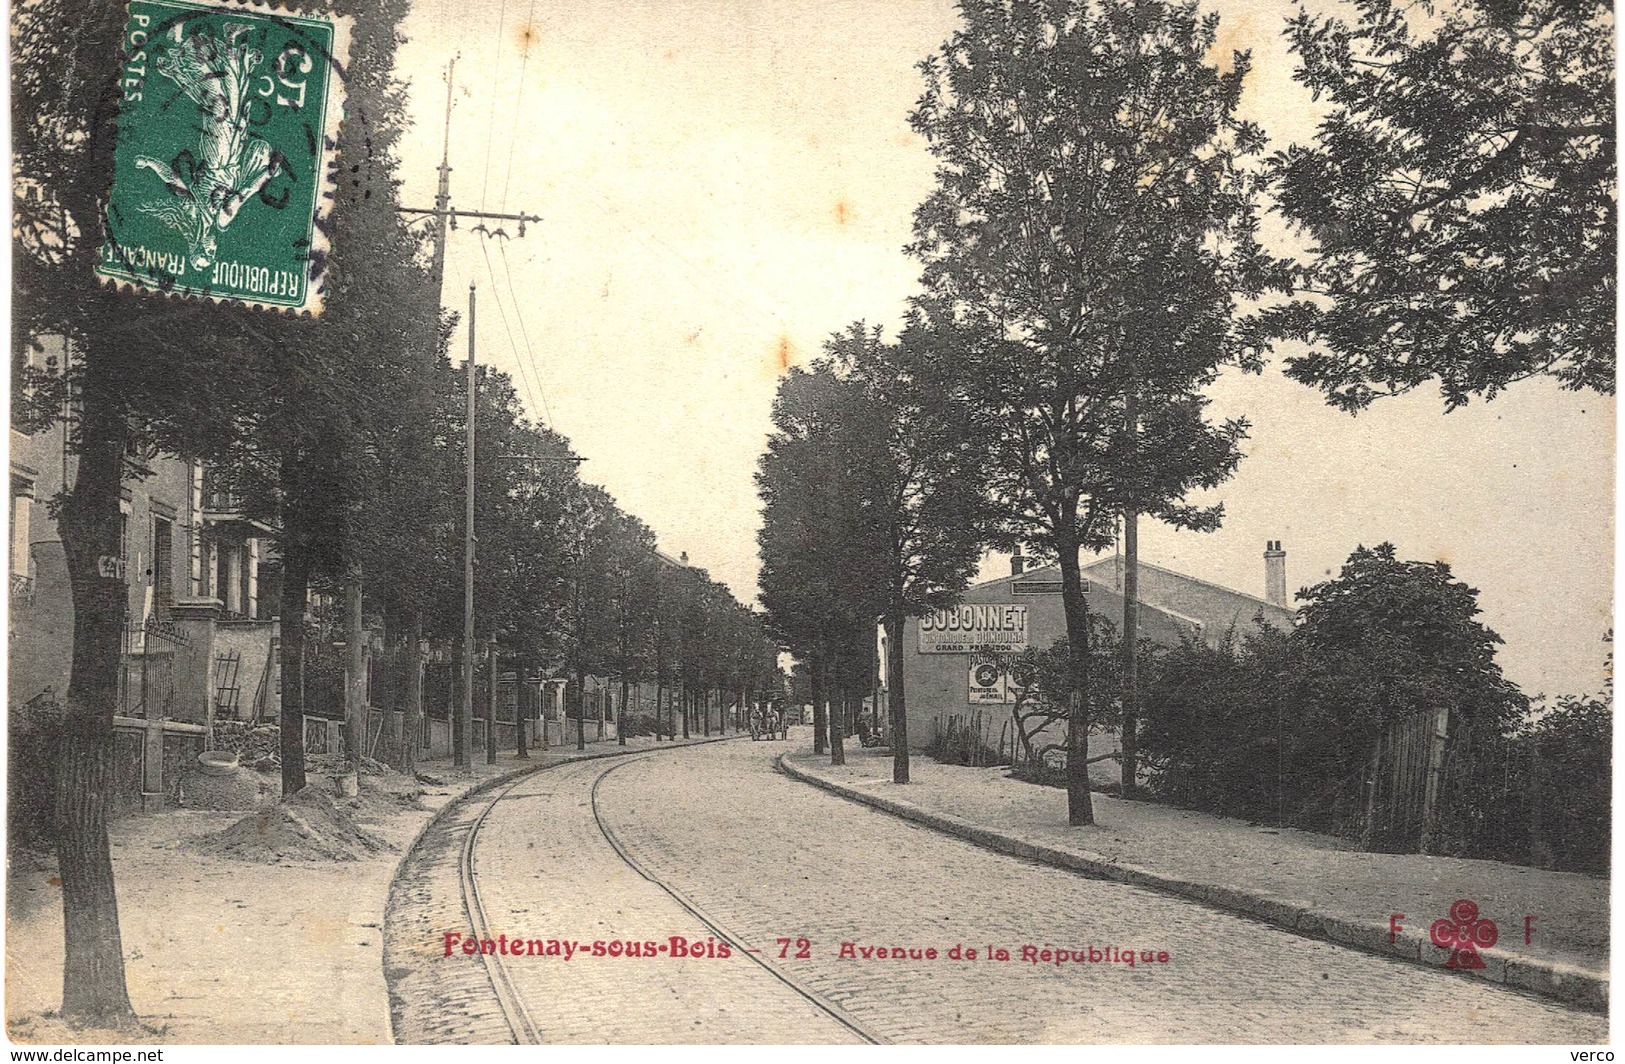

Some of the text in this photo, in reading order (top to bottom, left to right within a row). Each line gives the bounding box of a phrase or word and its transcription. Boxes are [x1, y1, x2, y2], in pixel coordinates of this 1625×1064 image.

[124, 13, 150, 103] POSTES
[276, 48, 313, 108] 5
[211, 260, 299, 297] REPUBLIQUE
[921, 604, 1027, 632] DUBONNET
[935, 644, 964, 652] GRAND
